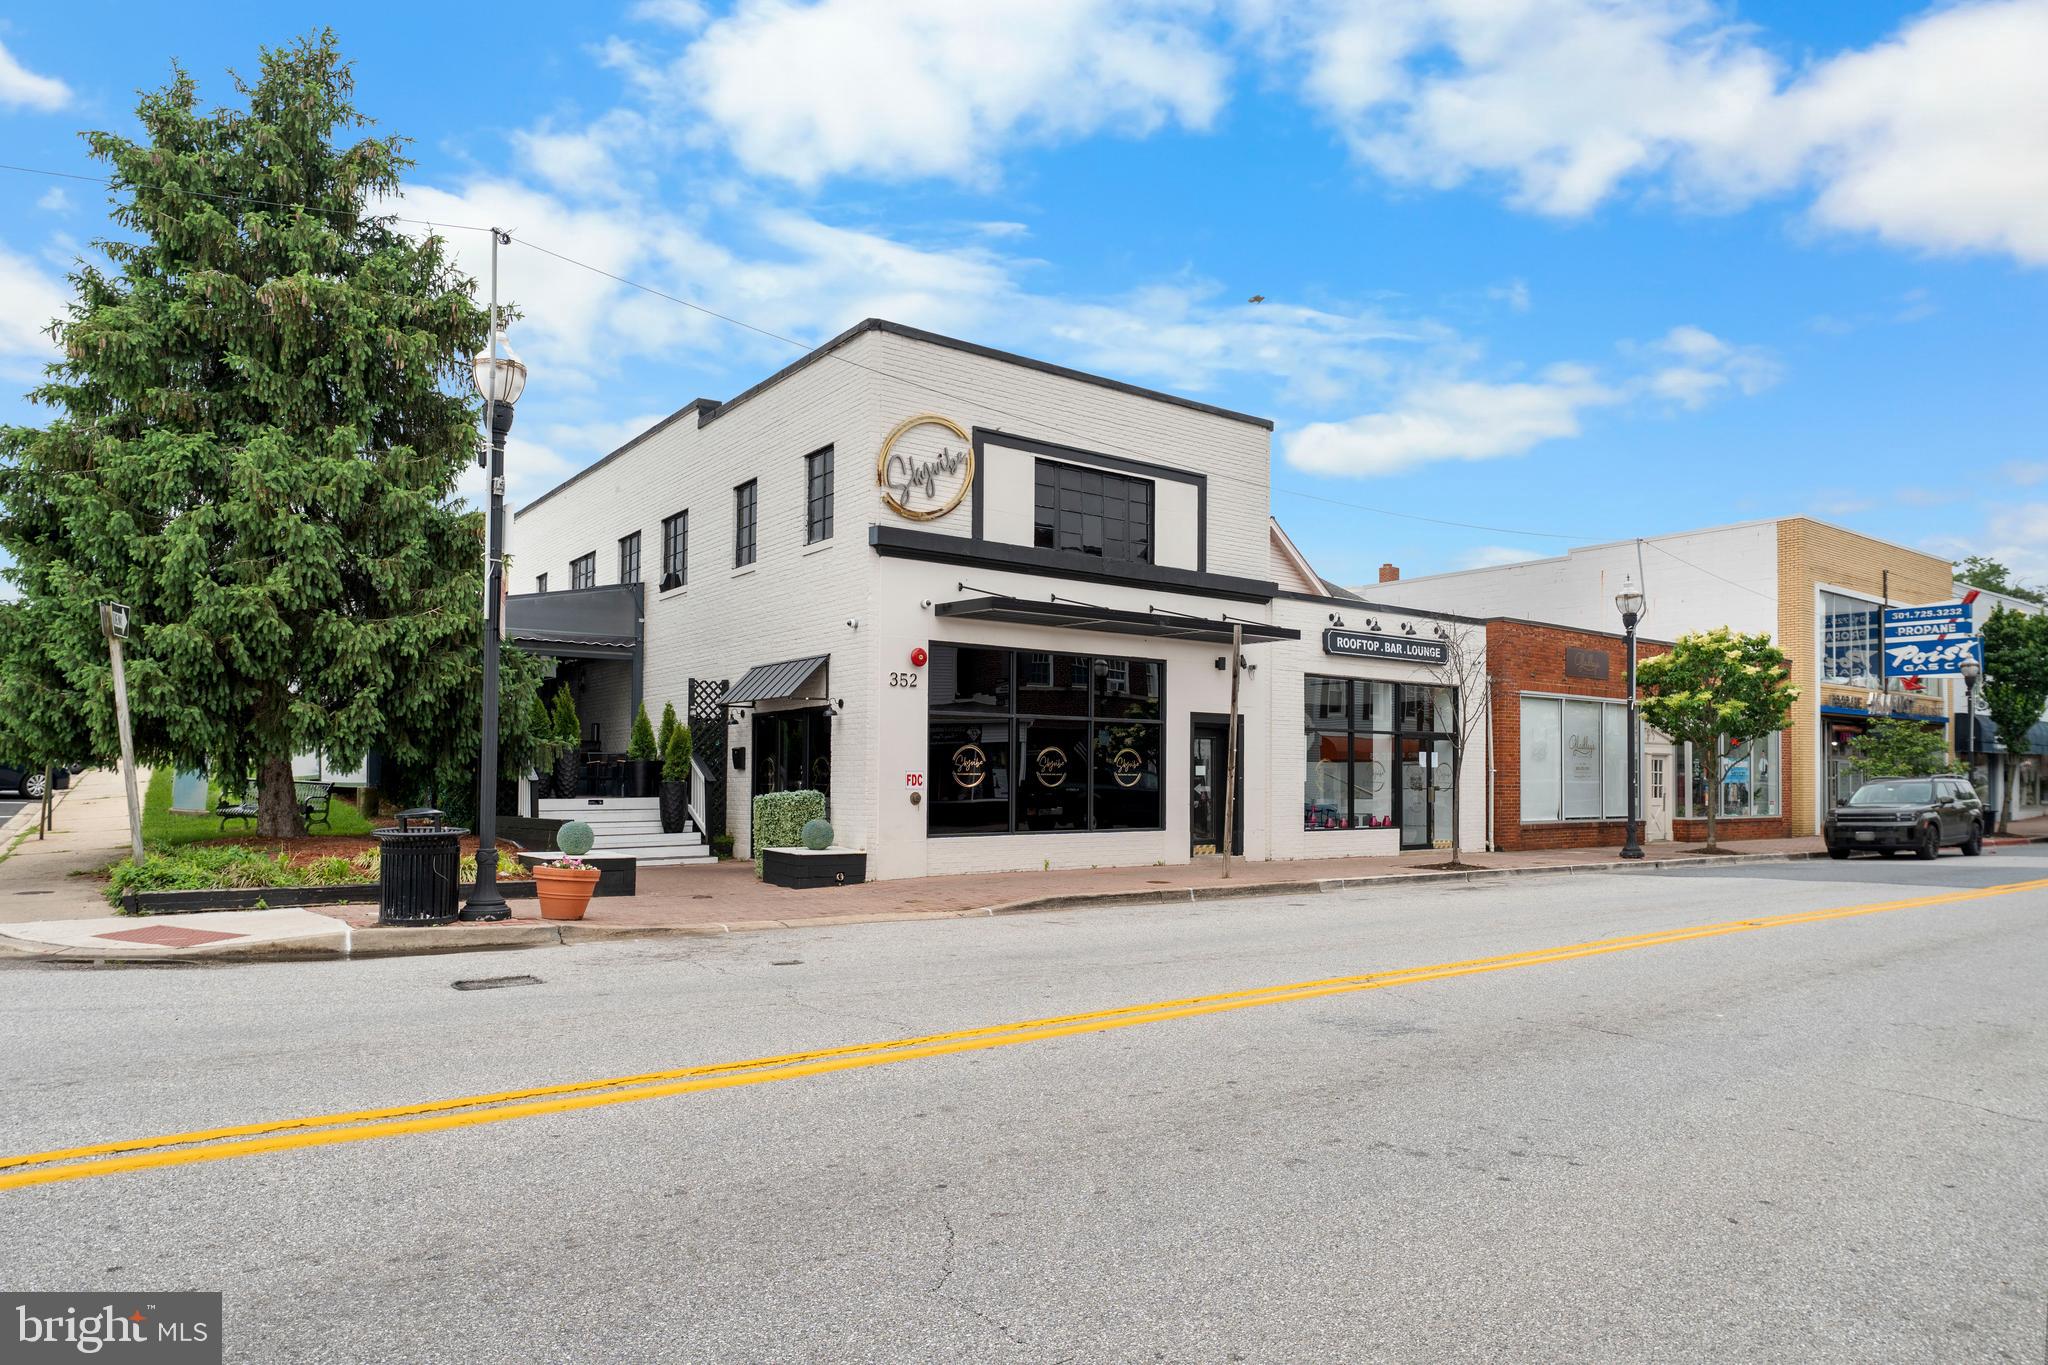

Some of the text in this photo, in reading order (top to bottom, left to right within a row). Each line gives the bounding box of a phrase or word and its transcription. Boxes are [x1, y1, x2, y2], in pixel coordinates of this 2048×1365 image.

[1892, 608, 1962, 619] 301.725.3232
[1898, 624, 1956, 635] PROPANE
[1407, 647, 1440, 657] LOUNGE
[1885, 640, 1979, 668] Poist
[1903, 663, 1939, 672] GAS
[890, 672, 917, 687] 352
[906, 774, 923, 786] FDC
